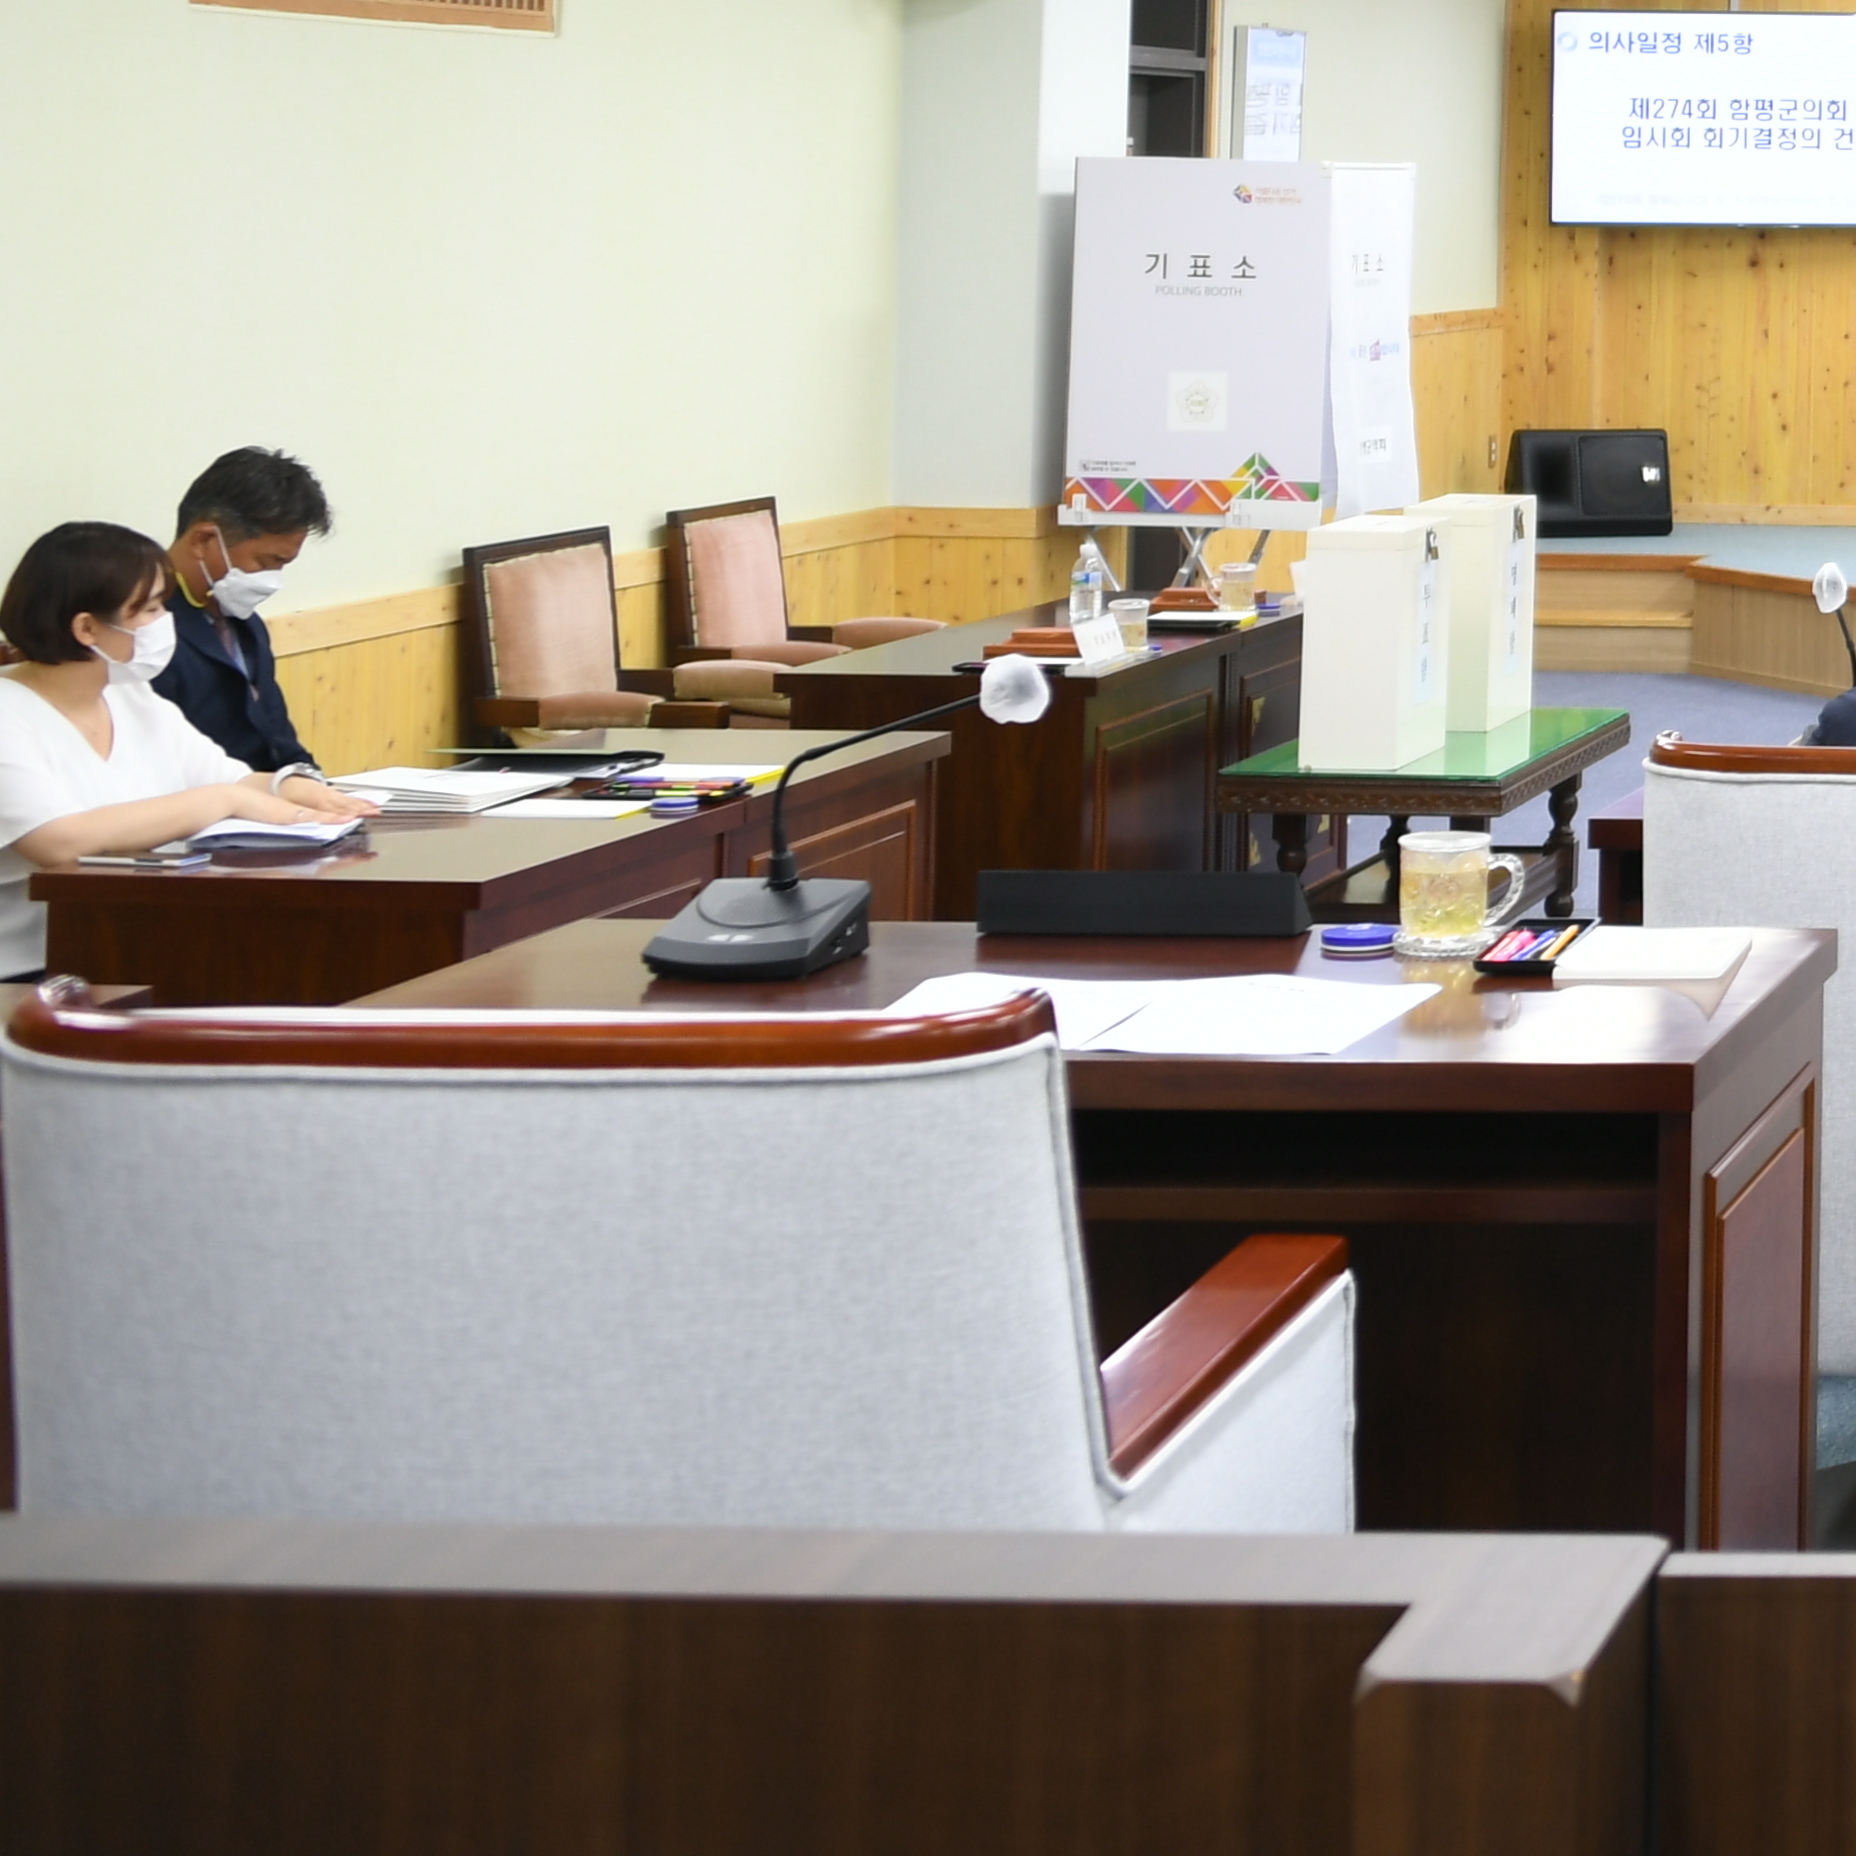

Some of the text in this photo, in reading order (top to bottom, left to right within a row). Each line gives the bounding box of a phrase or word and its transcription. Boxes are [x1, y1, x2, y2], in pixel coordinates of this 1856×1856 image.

[1588, 31, 1754, 56] 의사일정 제5항
[1627, 97, 1848, 124] 제274회 함평군의회
[1621, 126, 1855, 151] 임시회 회기결정의 건
[1154, 285, 1243, 297] POLLING BOOTH
